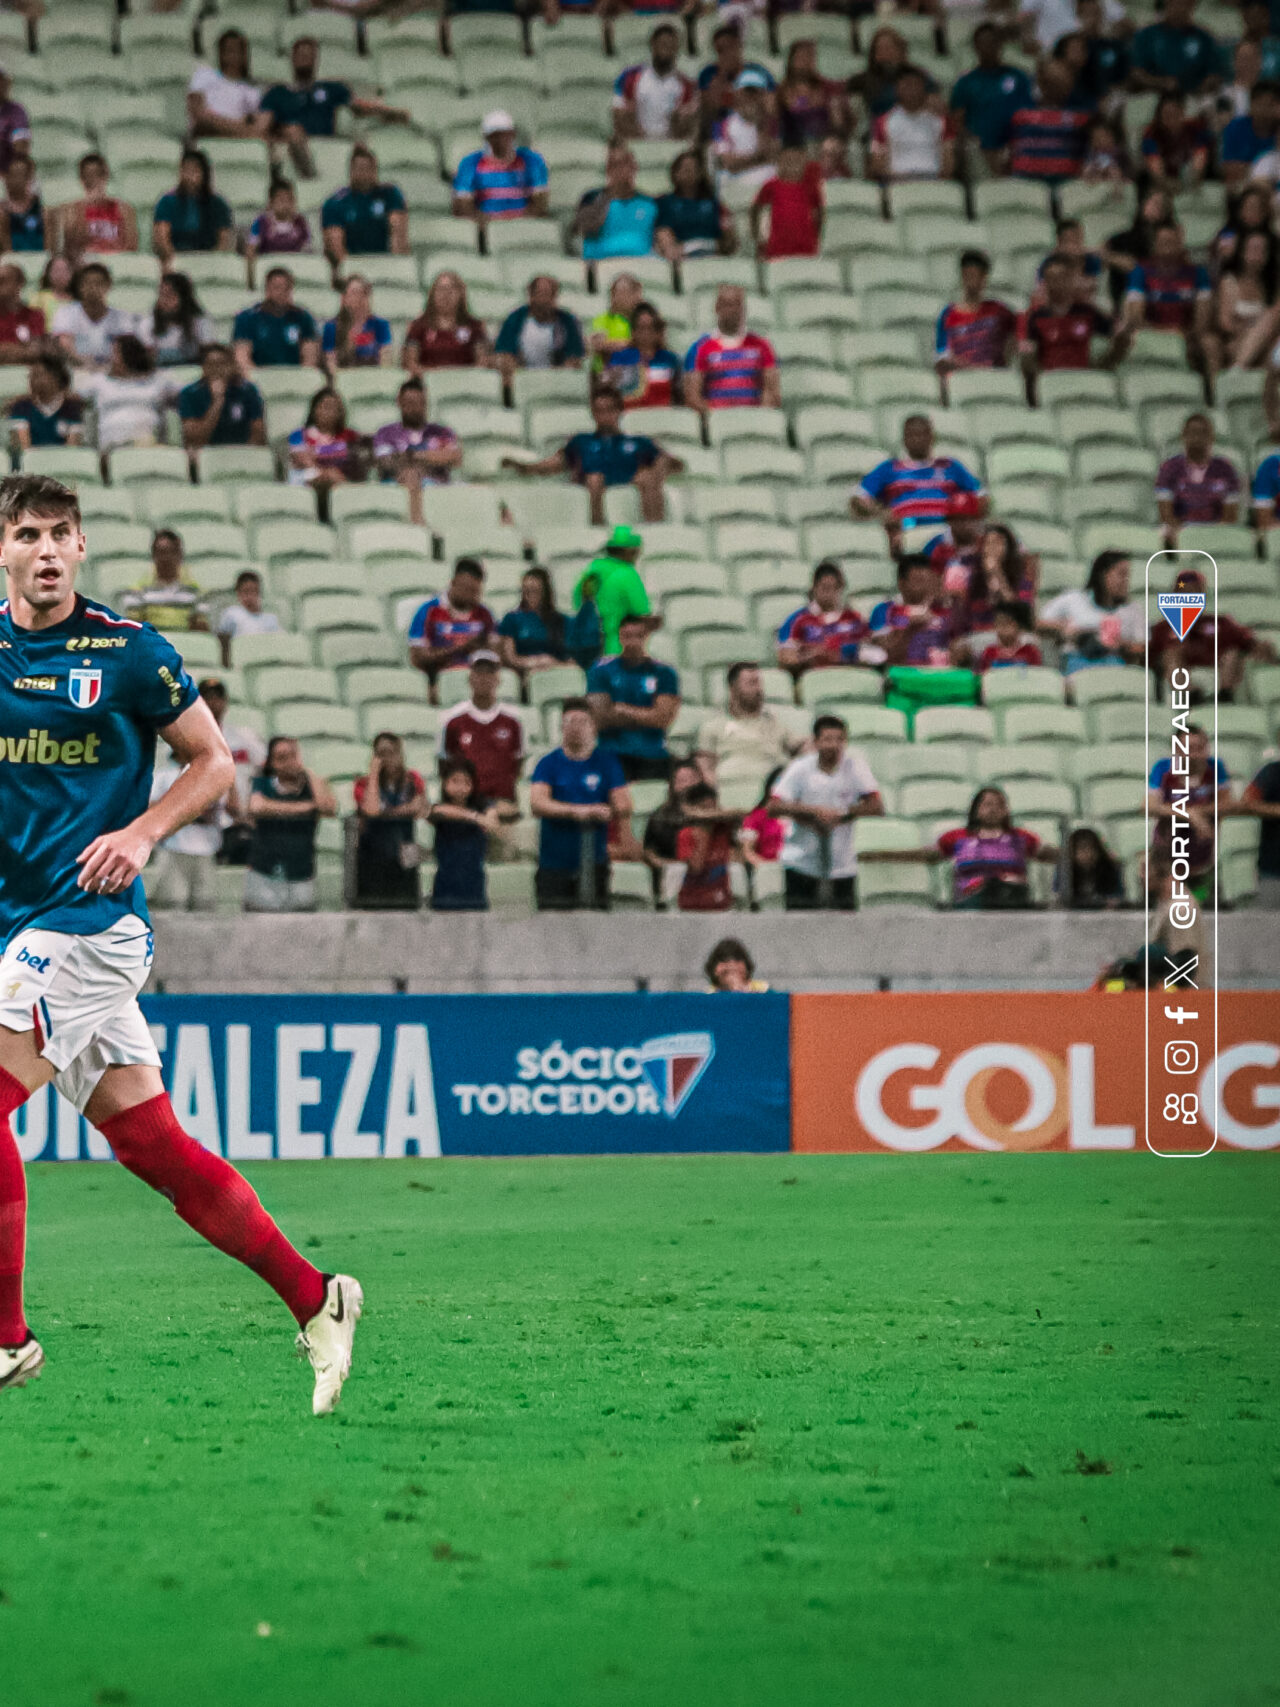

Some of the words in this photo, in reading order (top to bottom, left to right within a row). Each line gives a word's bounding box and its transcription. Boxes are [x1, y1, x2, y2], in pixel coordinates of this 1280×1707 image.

[90, 635, 128, 648] zenir
[517, 1041, 643, 1080] SÓCIO
[452, 1083, 660, 1115] TORCEDOR
[855, 1041, 1136, 1152] GOL
